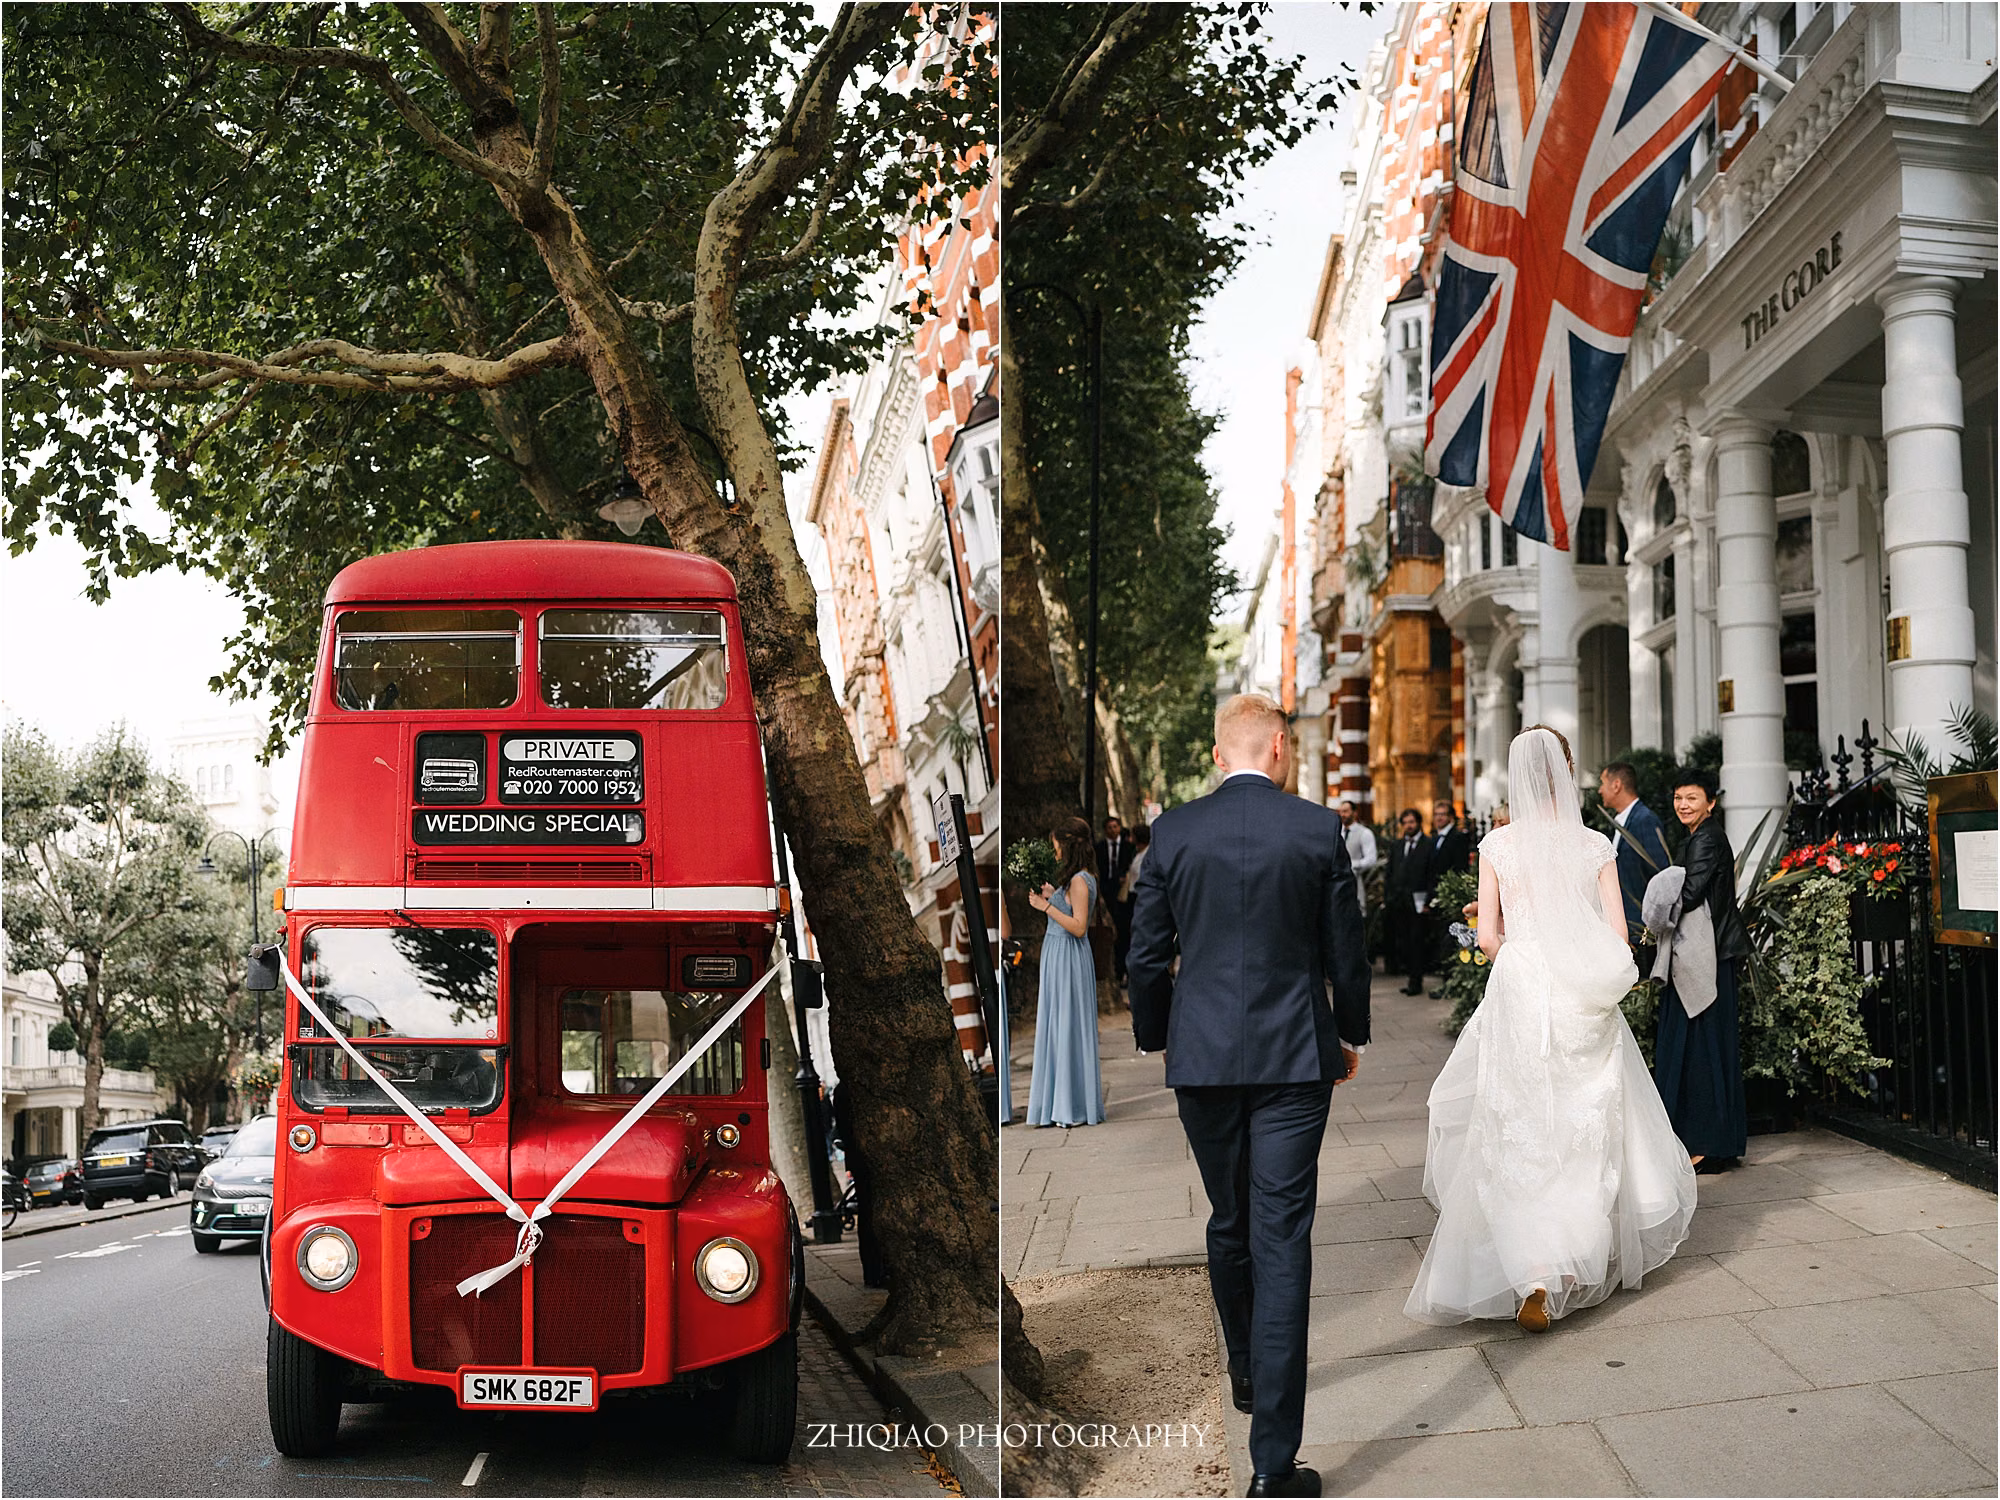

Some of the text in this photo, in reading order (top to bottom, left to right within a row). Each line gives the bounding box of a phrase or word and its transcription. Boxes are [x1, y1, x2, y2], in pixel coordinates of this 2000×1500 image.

[1741, 231, 1842, 350] THE GORE
[524, 741, 615, 759] PRIVATE
[508, 766, 632, 778] RedRoutemaster.com
[523, 780, 637, 795] 020 7000 1952
[424, 814, 634, 832] WEDDING SPECIAL
[473, 1378, 583, 1402] SMK 682F
